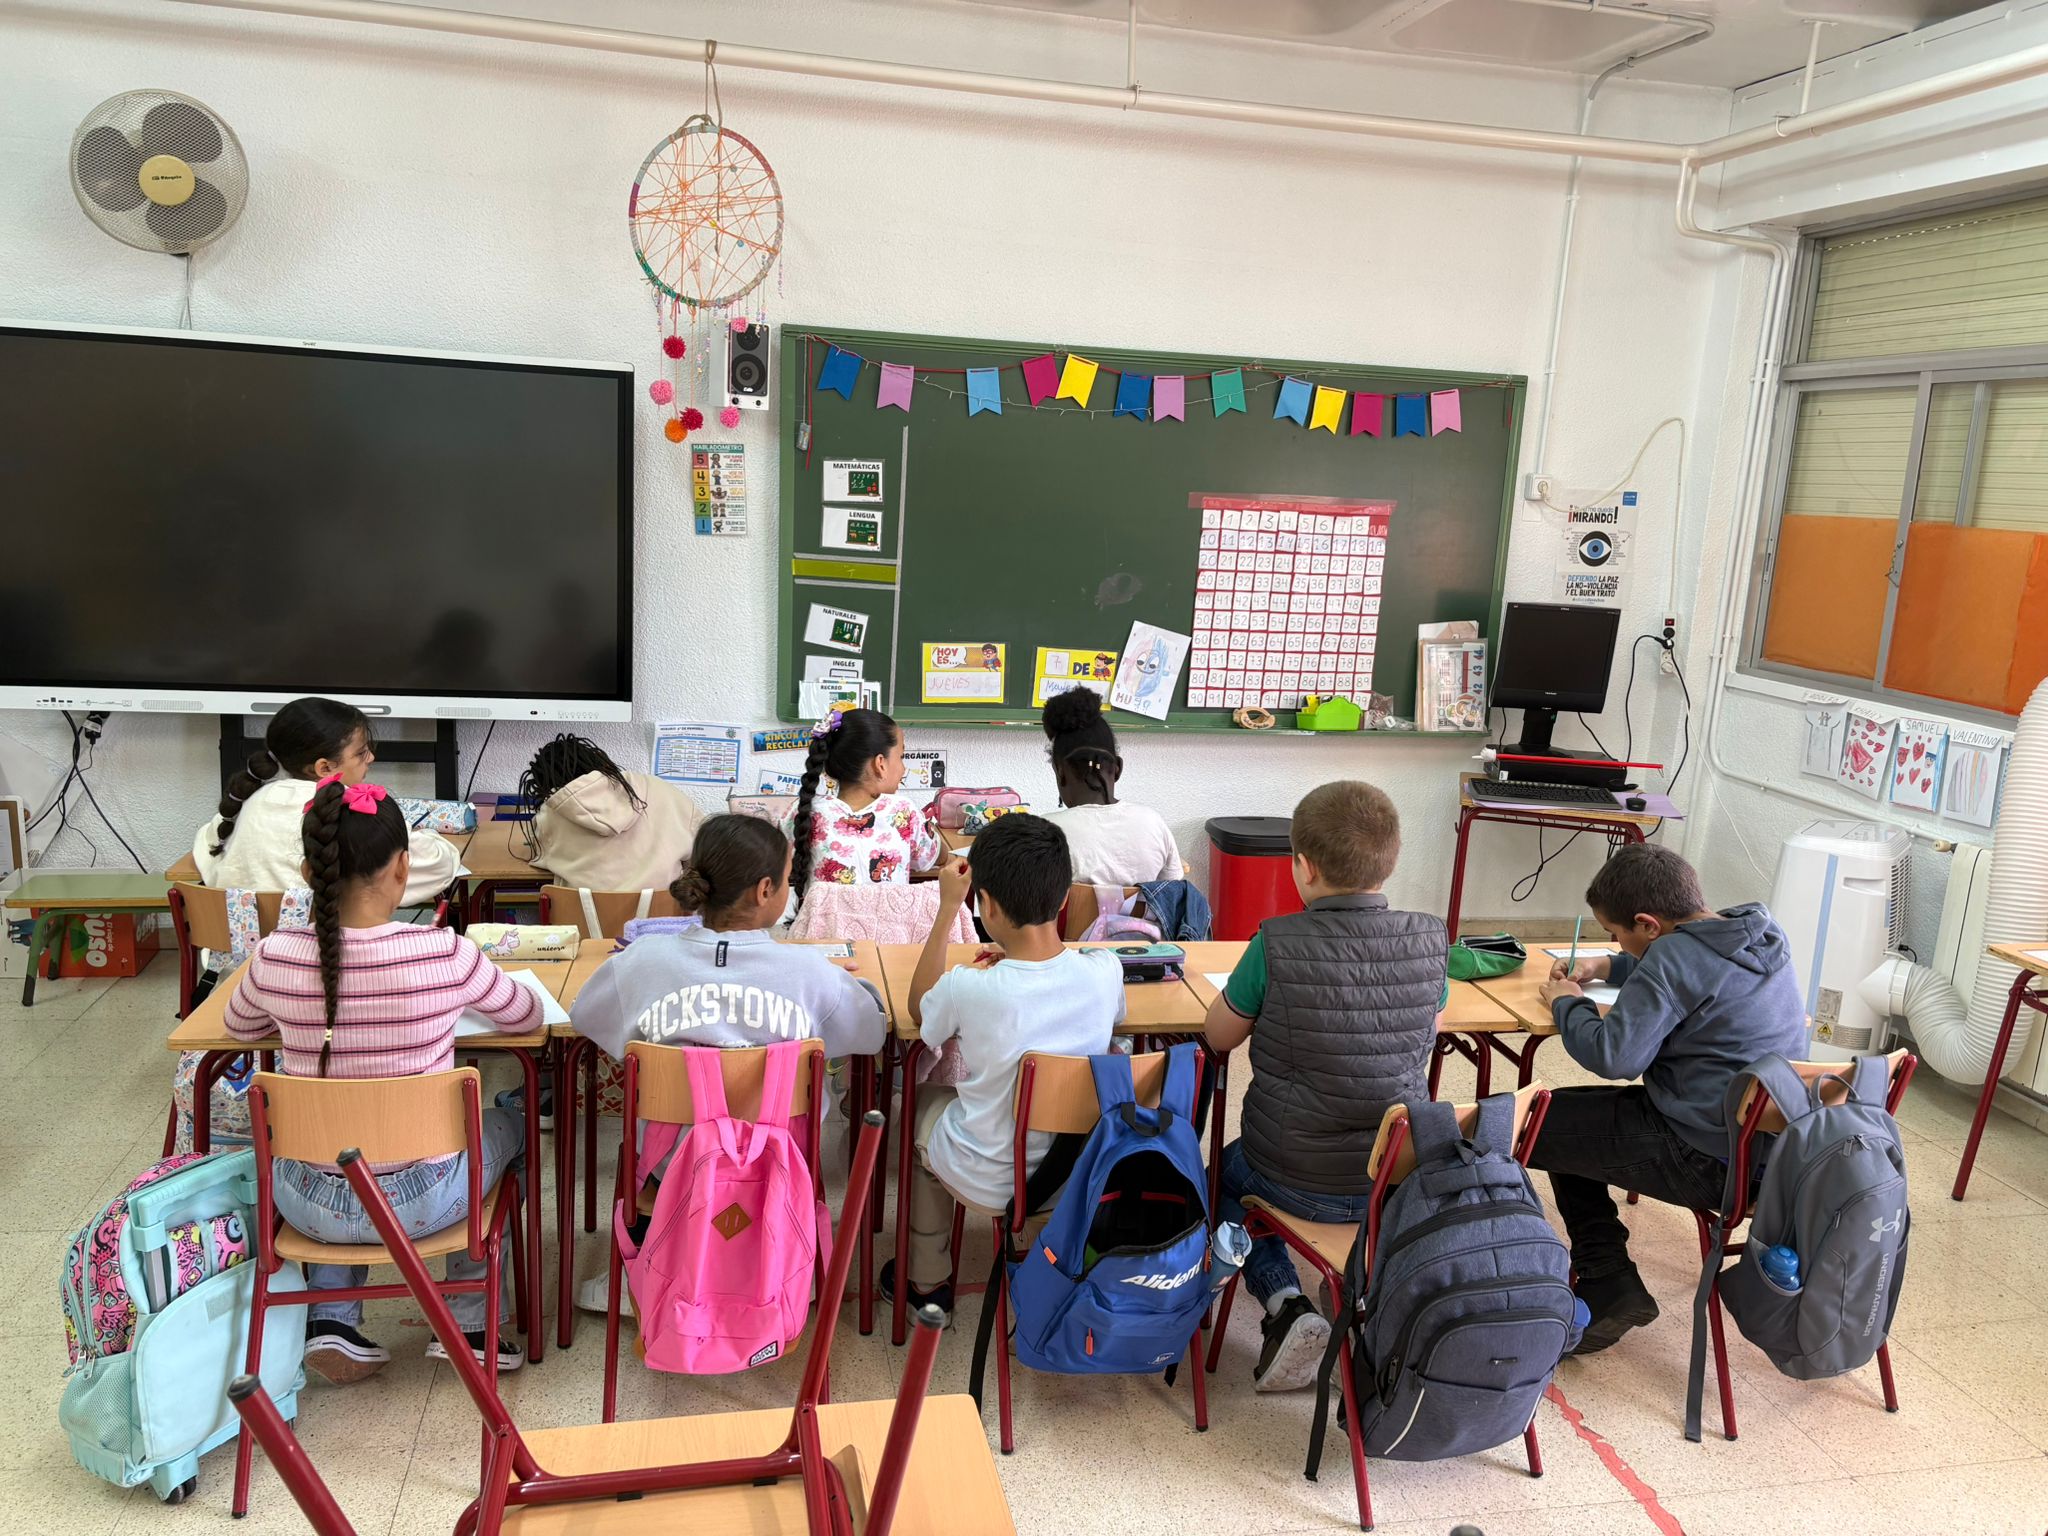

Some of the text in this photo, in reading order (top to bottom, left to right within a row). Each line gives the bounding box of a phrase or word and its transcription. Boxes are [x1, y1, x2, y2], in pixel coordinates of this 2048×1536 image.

[696, 454, 704, 464] 5
[697, 471, 706, 480] 4
[698, 487, 706, 496] 3
[700, 504, 706, 512] 2
[1568, 506, 1618, 524] ¡MIRANDO!
[1208, 514, 1216, 525] 0
[1266, 515, 1274, 528] 3
[1283, 516, 1292, 528] 4
[1302, 518, 1309, 528] 5
[1320, 517, 1328, 530] 6
[1356, 519, 1363, 531] 8
[1202, 534, 1215, 545] 10
[1222, 534, 1235, 545] 11
[1240, 535, 1254, 547] 12
[1259, 536, 1273, 548] 13
[1279, 536, 1293, 549] 14
[1314, 538, 1329, 550] 16
[1333, 539, 1347, 551] 17
[1352, 538, 1365, 552] 18
[1201, 553, 1381, 572] 20 21 22 23 24 25 26 27 28 29
[1200, 574, 1379, 591] 30 31 32 33 34 35 36 37 38 39
[1198, 595, 1377, 610] 40 41 42 43 44 45 46 47 48 49
[822, 608, 856, 620] NATURALES
[1197, 613, 1375, 630] 50 51 52 53 54 55 56 57 58 59
[1195, 633, 1373, 649] 60 61 62 63 64 65 66 67 68 69
[936, 647, 958, 657] HOY
[1474, 650, 1484, 660] 44
[936, 656, 958, 665] ES...
[1053, 655, 1062, 668] 7
[1194, 653, 1371, 670] 70 71 72 73 74 75 76 77 78 79
[1073, 662, 1090, 676] DE
[1473, 666, 1482, 676] 43
[929, 678, 969, 690] JUEVES
[1192, 671, 1369, 688] 80 81 82 83 84 85 86 87 88 89
[1473, 684, 1483, 694] 42
[1191, 693, 1203, 704] 90
[1208, 693, 1220, 704] 91
[1228, 693, 1240, 705] 92
[1246, 693, 1258, 705] 93
[1265, 694, 1278, 706] 94
[1906, 722, 1943, 735] SAMUEL
[1953, 729, 1999, 745] VALENTINO
[777, 775, 801, 785] PAPEL
[1862, 1253, 1889, 1337] UNDER ARMOUR
